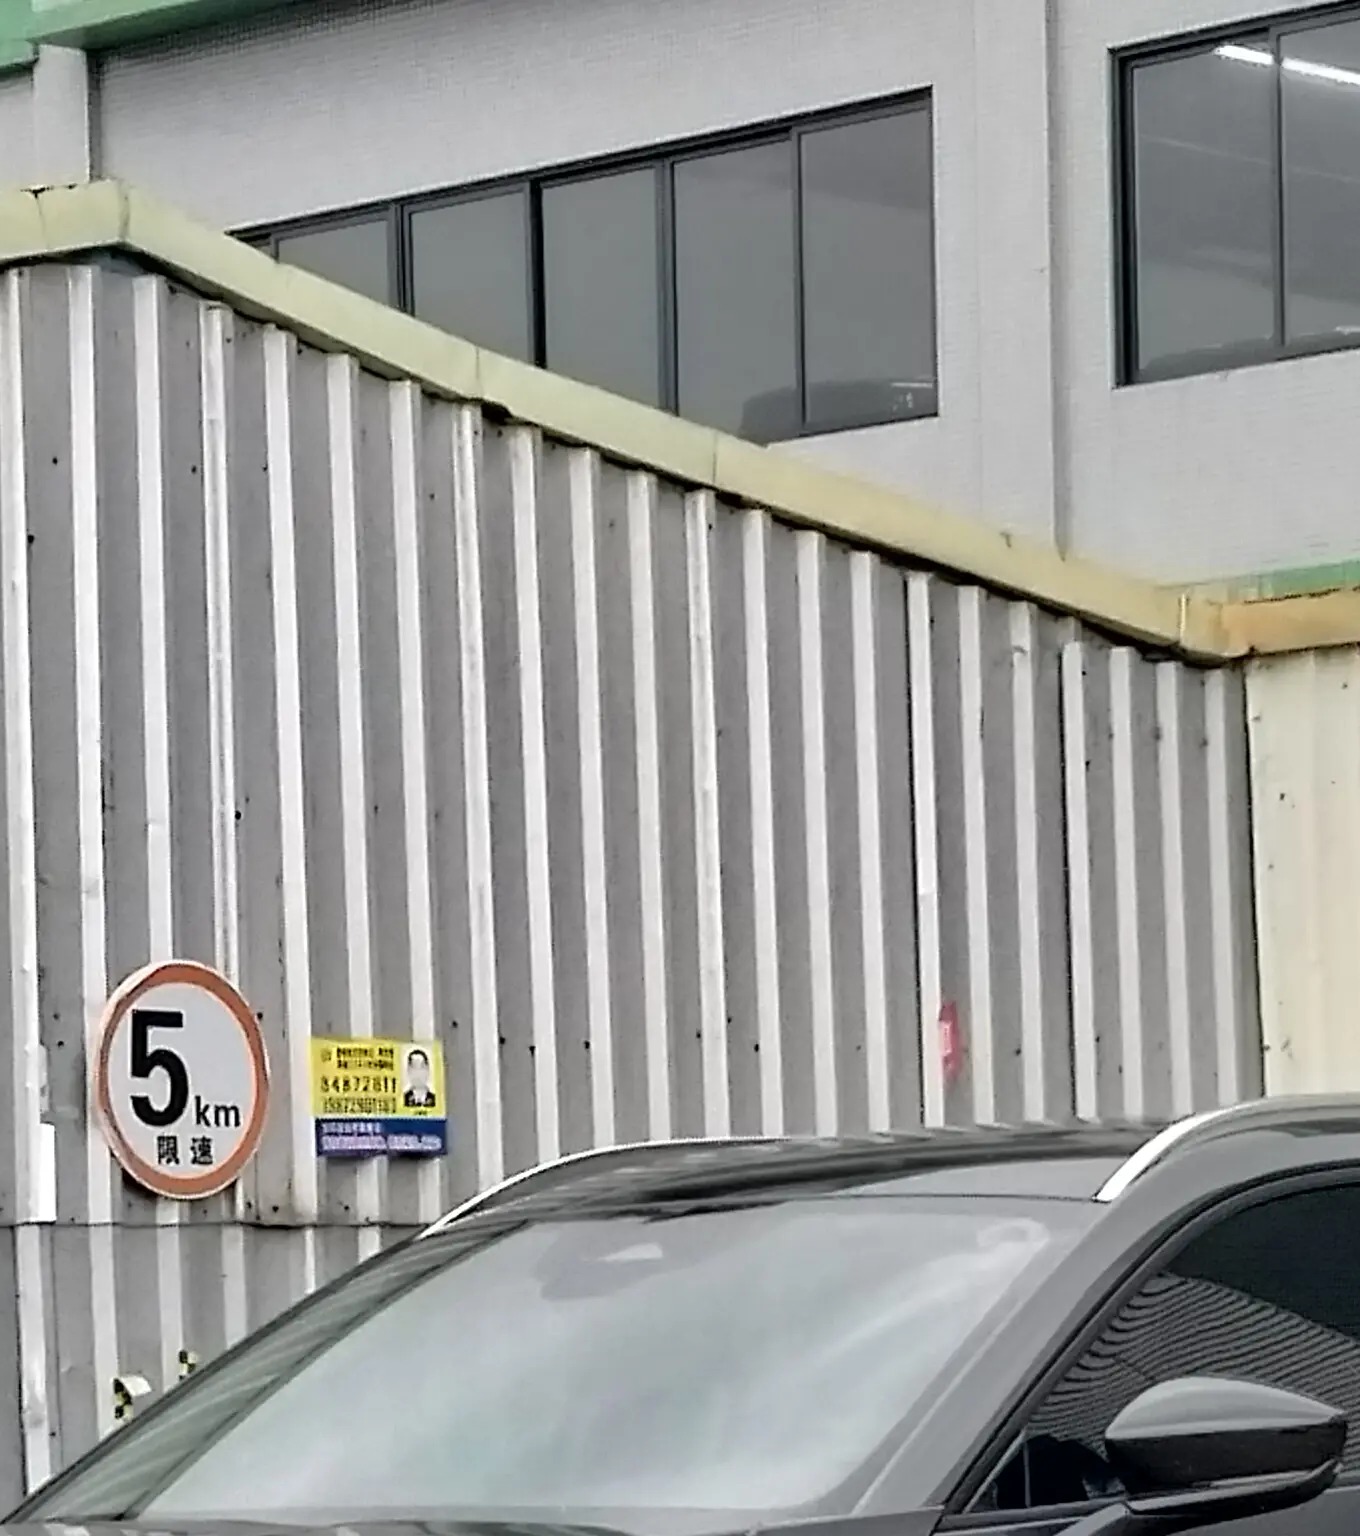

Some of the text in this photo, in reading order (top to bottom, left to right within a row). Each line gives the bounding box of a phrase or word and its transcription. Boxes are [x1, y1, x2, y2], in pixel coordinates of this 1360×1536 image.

[129, 1009, 241, 1128] 5 km
[156, 1134, 215, 1166] 限速
